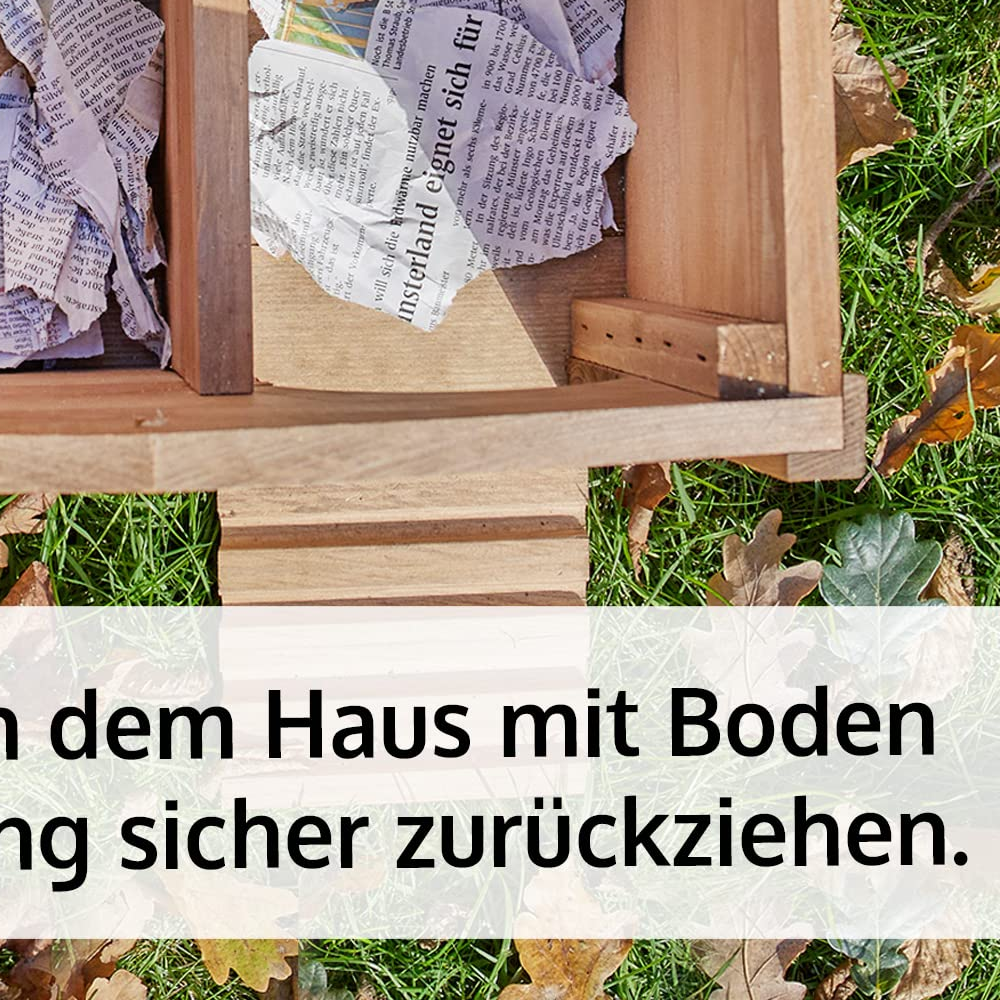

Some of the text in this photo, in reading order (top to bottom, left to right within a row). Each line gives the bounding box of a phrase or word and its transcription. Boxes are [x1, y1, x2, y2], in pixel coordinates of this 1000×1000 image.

[74, 12, 103, 33] Thema
[80, 8, 132, 43] Die Prozesse
[382, 38, 396, 67] Thomas
[393, 16, 413, 70] Landesbetrieb
[453, 14, 483, 52] für
[481, 19, 508, 90] in 900 bis 1700
[441, 62, 472, 110] sich
[351, 91, 371, 155] auf jeden Fall
[422, 116, 458, 193] eignet
[521, 108, 543, 168] Ingo Schäfer,
[374, 65, 436, 301] will sich die Erdwärme nutzbar machen
[475, 104, 508, 223] In der Sitzung des Regio-
[497, 107, 530, 237] regierung Münster angesie-
[519, 112, 553, 241] vom Geologischen Dienst
[552, 138, 582, 248] Ultraschallbild entdeckt
[578, 159, 601, 232] für Geothermie.
